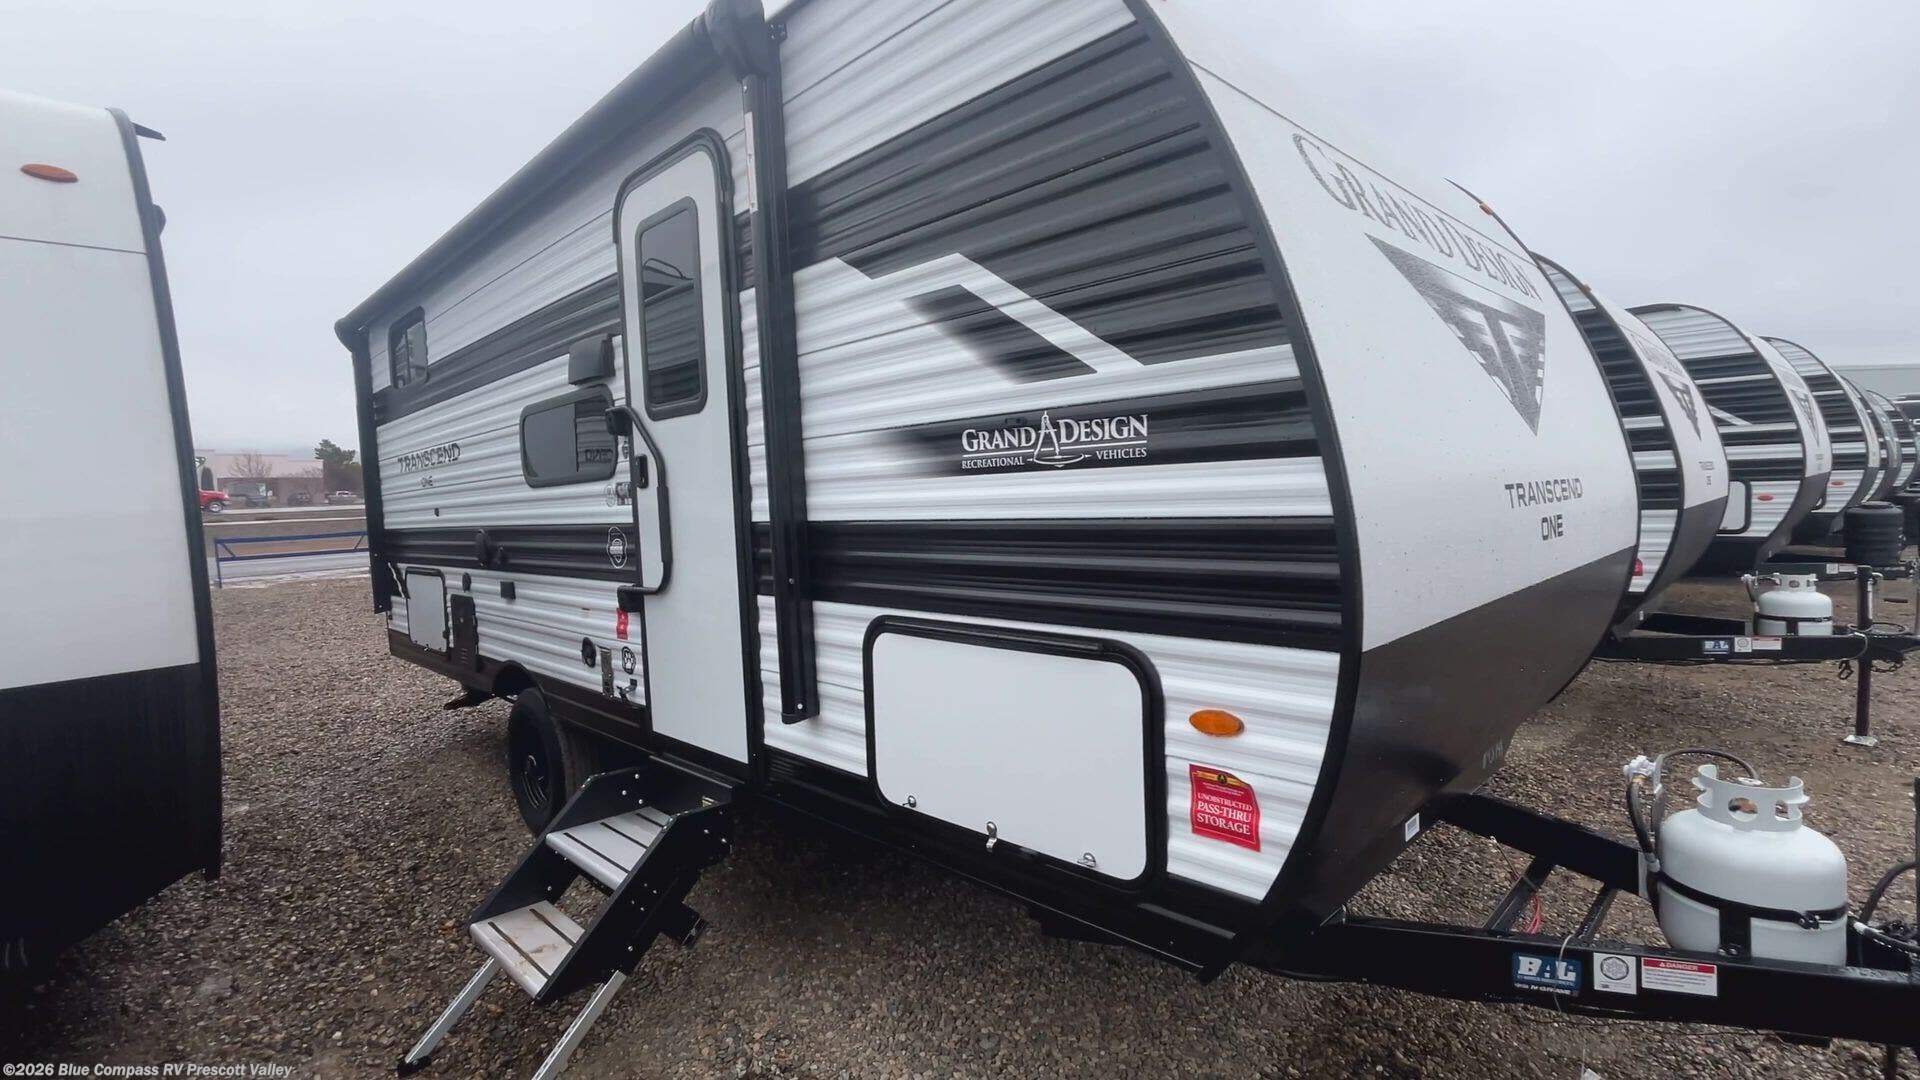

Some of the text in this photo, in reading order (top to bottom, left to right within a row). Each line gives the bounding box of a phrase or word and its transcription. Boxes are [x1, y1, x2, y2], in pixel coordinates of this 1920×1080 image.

[1292, 133, 1543, 301] GRAND DESIGN
[962, 414, 1149, 452] GRAND DESIGN
[397, 442, 461, 473] TRANSCEND
[961, 447, 1148, 469] RECREATIONAL VEHICLES
[1504, 478, 1583, 509] TRANSCEND
[1541, 513, 1564, 541] ONE
[1197, 792, 1253, 812] UNOBSTRUCTED
[1197, 800, 1252, 823] PASS-THRU
[1196, 812, 1251, 835] STORAGE
[1667, 962, 1699, 971] DANGER
